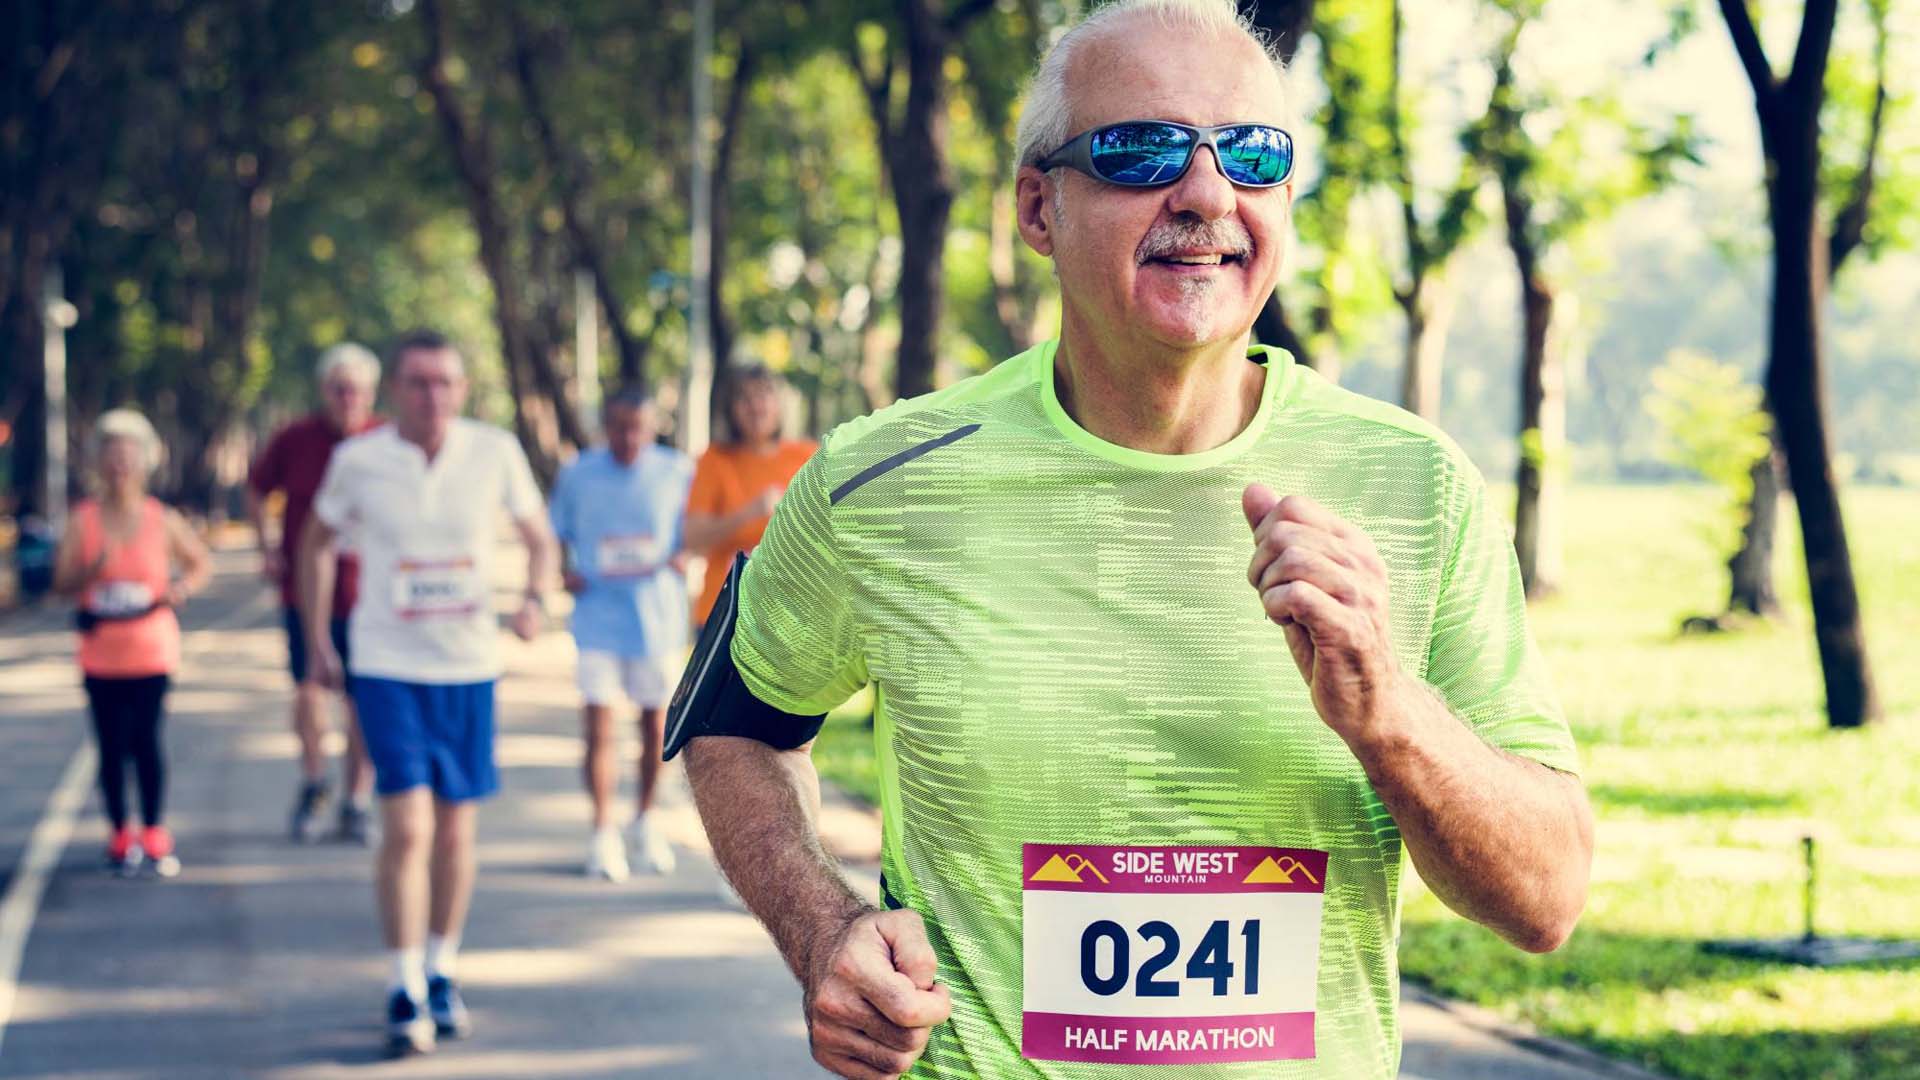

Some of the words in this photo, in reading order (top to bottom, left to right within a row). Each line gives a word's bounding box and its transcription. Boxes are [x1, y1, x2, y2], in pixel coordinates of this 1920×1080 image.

[1112, 852, 1165, 874] SIDE
[1173, 852, 1239, 874] WEST
[1144, 874, 1206, 884] MOUNTAIN
[1080, 919, 1260, 997] 0241
[1065, 1027, 1128, 1050] HALF
[1136, 1027, 1275, 1051] MARATHON
